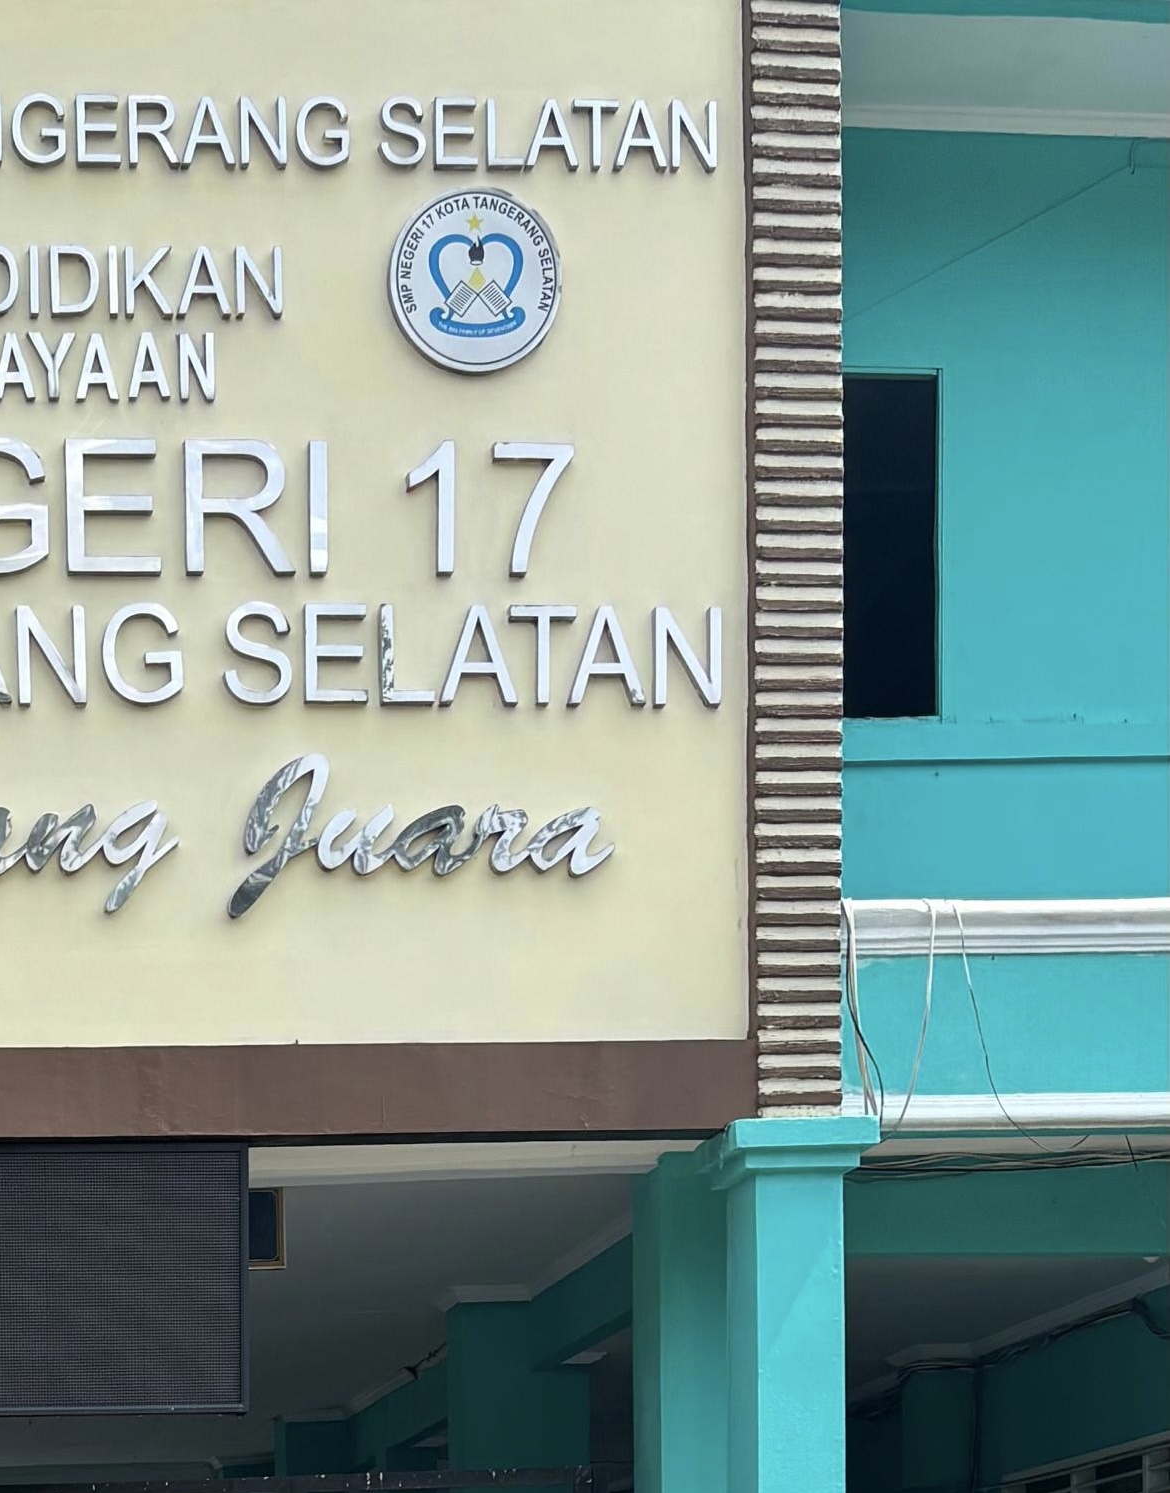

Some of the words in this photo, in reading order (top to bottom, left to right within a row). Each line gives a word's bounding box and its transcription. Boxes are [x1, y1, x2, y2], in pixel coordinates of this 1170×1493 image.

[379, 94, 720, 174] SELATAN
[421, 211, 435, 230] 17
[435, 197, 470, 221] KOTA
[473, 196, 545, 247] TANGERANG
[401, 228, 424, 280] NEGERI
[538, 248, 554, 313] SELATAN
[401, 284, 417, 314] SMP
[405, 439, 576, 578] 17
[223, 602, 723, 709] SELATAN
[226, 752, 616, 920] Juara
